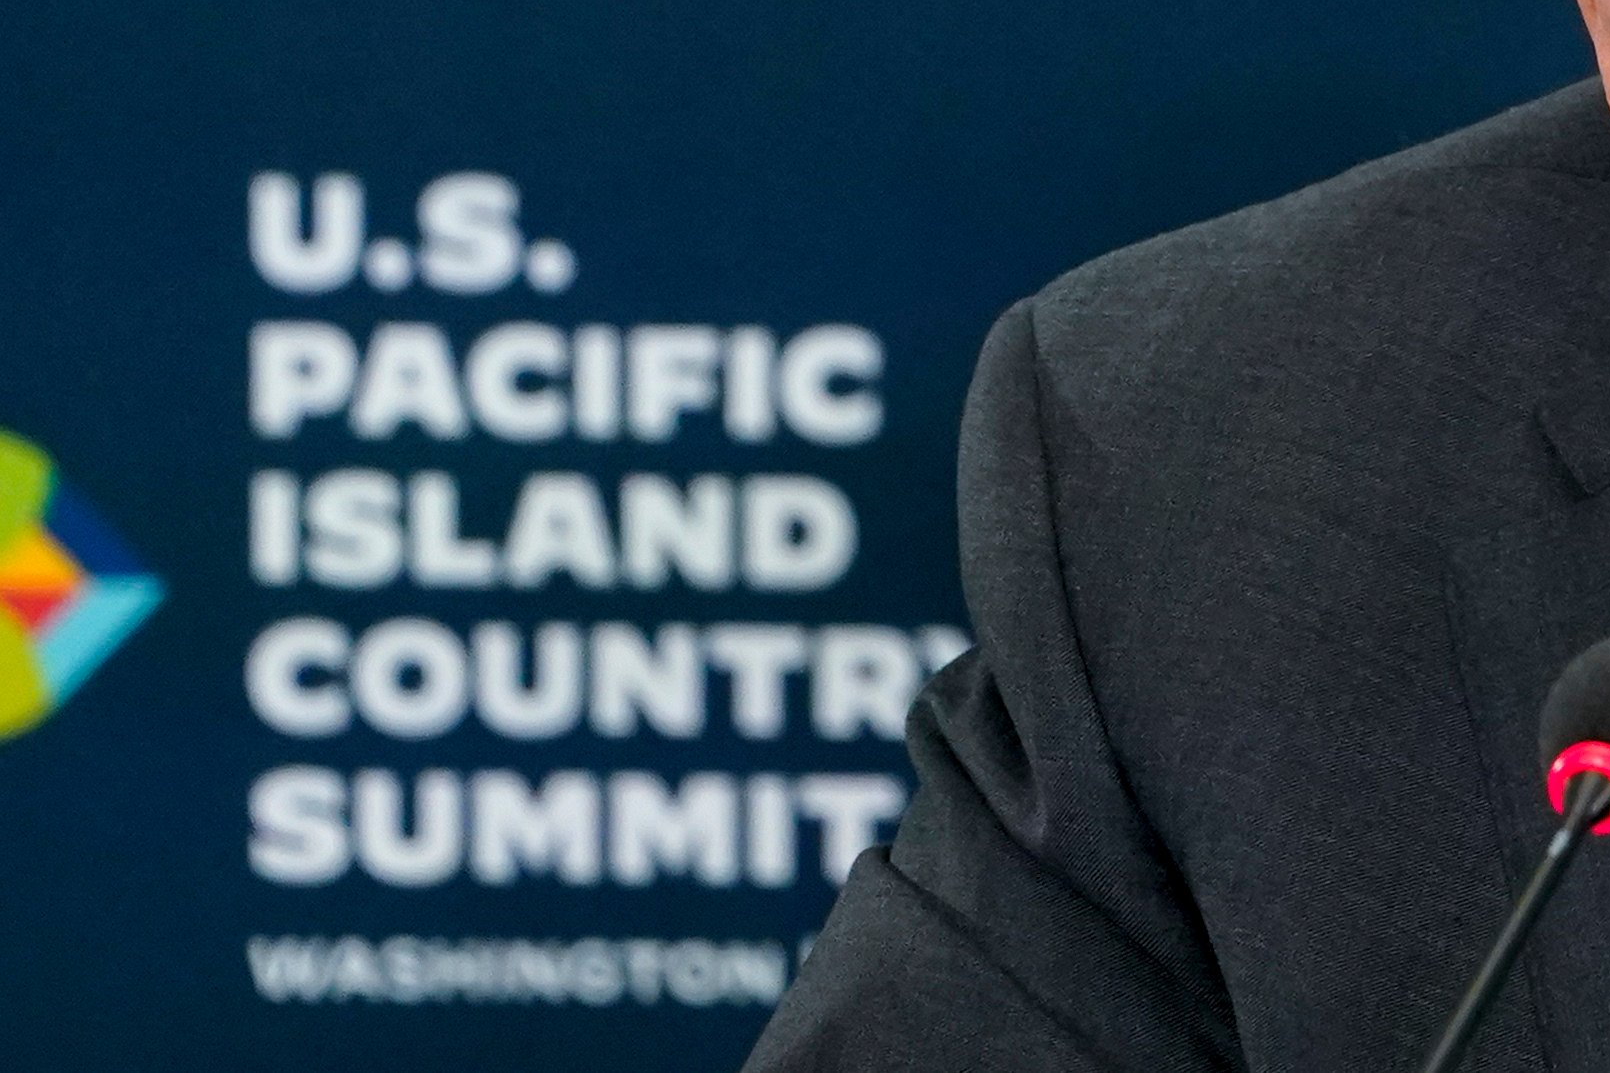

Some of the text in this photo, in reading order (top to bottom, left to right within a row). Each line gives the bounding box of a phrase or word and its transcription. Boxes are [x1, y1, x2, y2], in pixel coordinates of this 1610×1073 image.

[248, 171, 575, 294] U.S.
[249, 320, 882, 444] PACIFIC
[249, 468, 857, 590] ISLAND
[245, 616, 977, 739] COUNTR
[248, 764, 906, 887] SUMMIT
[246, 935, 787, 1005] WASHINGTON
